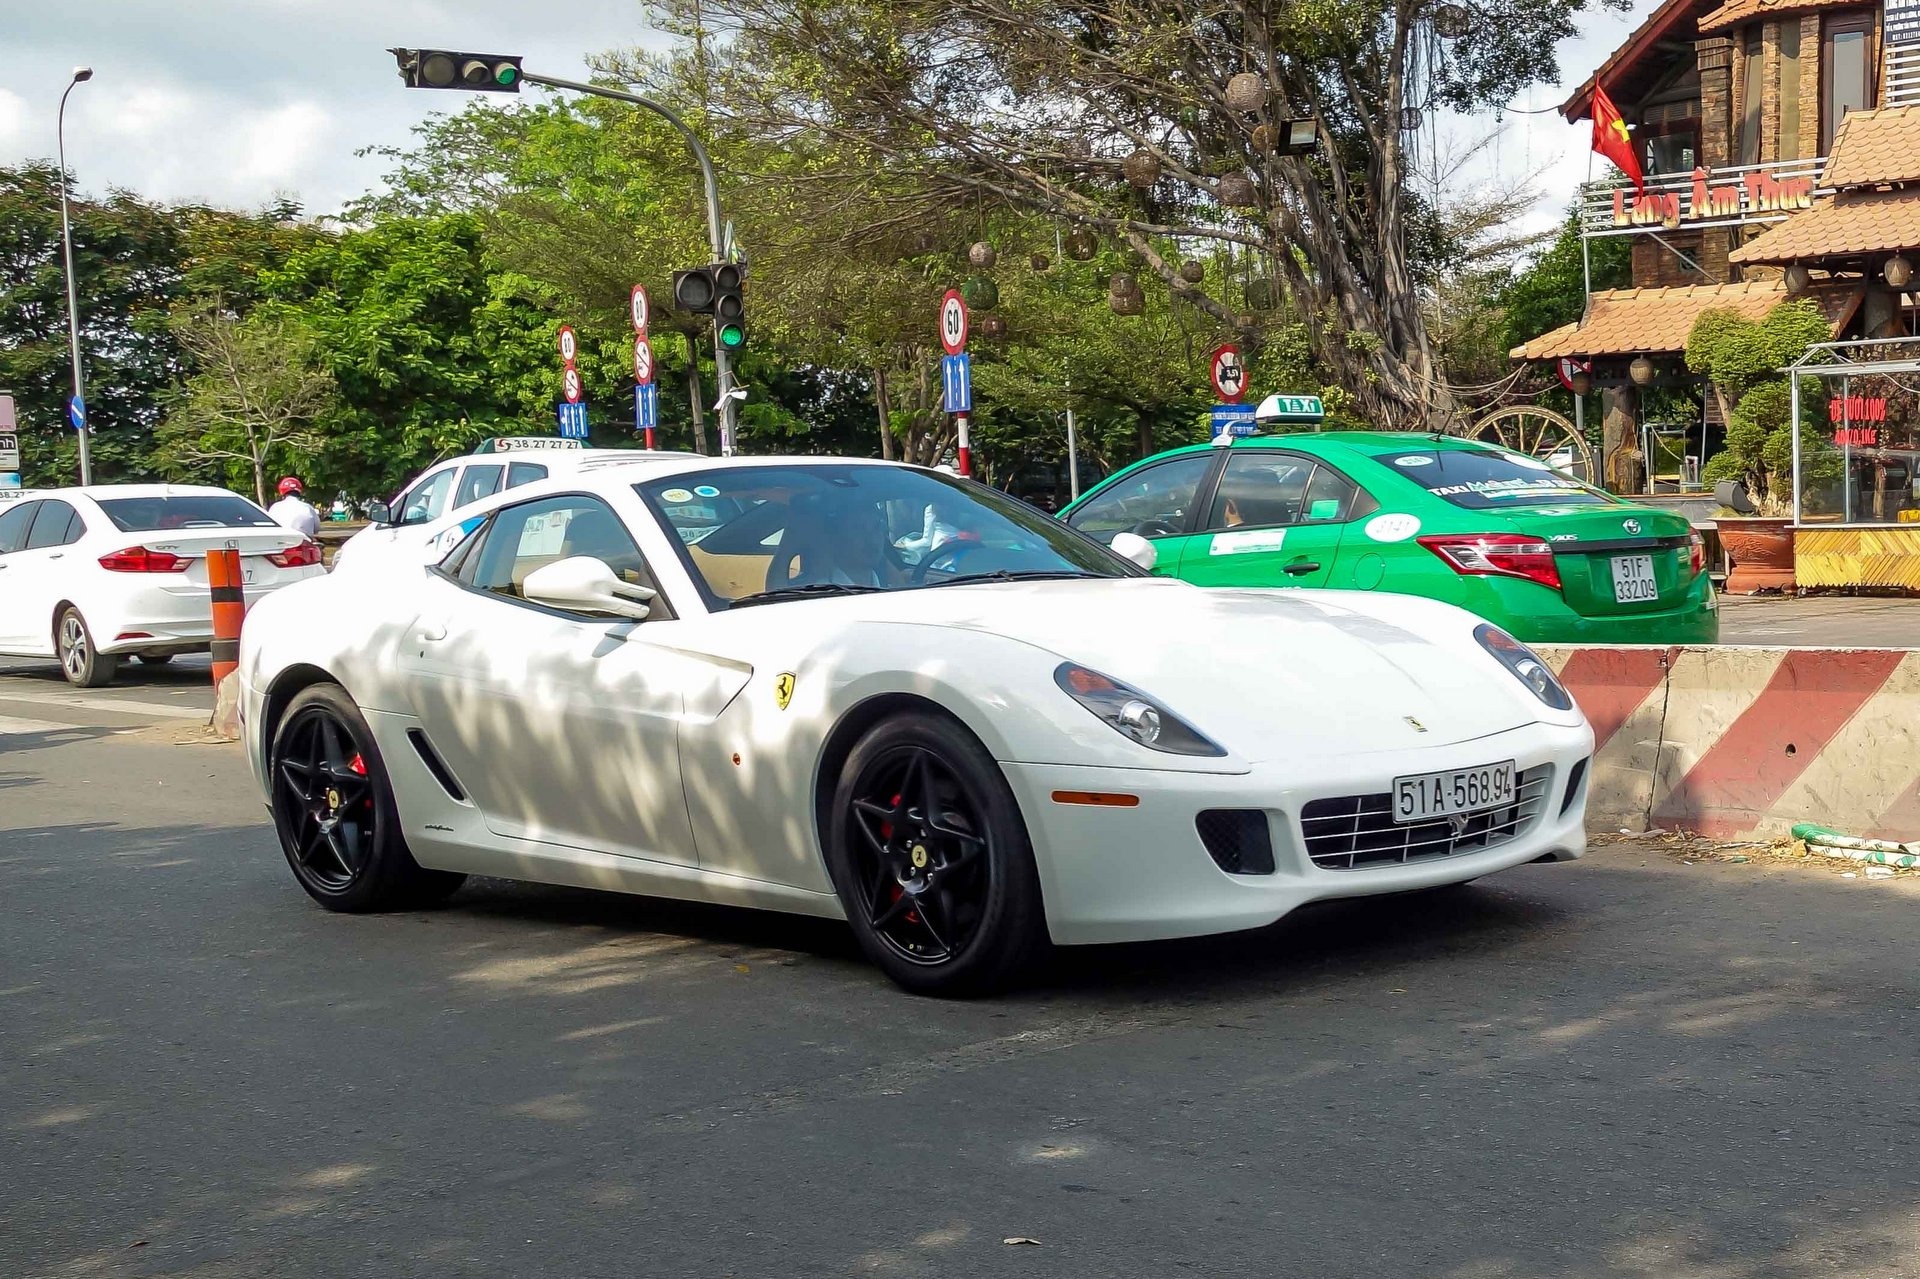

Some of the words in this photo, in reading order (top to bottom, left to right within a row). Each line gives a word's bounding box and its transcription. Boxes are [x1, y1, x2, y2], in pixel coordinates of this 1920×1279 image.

[947, 309, 959, 335] 60
[514, 439, 546, 449] 38.27
[549, 440, 563, 449] 27
[565, 440, 579, 450] 27
[1621, 558, 1643, 578] 51F
[1400, 766, 1512, 815] 51A-568.94
